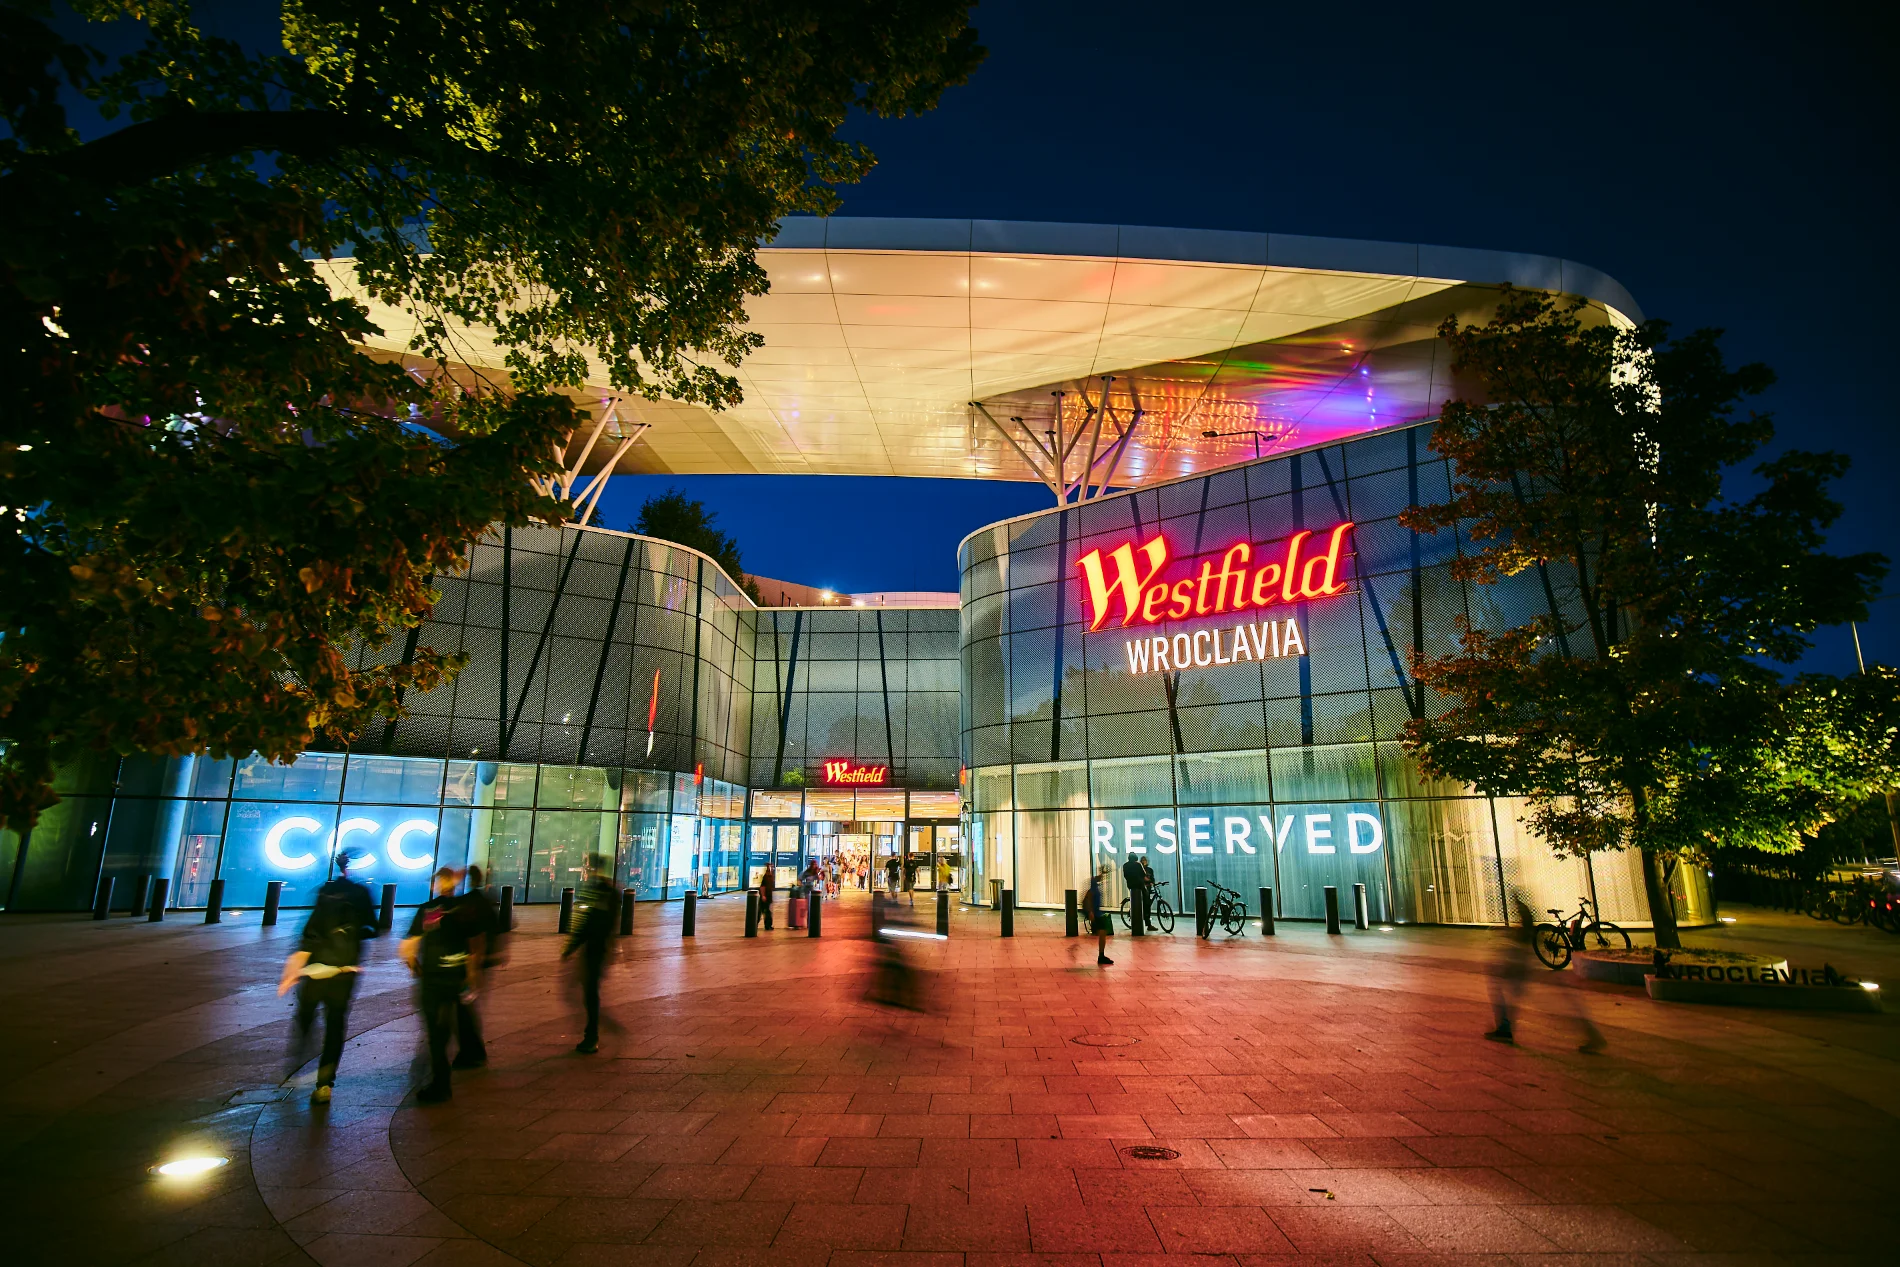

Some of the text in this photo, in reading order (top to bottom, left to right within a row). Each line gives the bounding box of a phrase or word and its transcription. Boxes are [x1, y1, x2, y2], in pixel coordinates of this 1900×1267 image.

[1075, 522, 1354, 631] Westfield
[1126, 618, 1305, 675] WROCLAVIA
[825, 761, 886, 783] Westfield
[264, 816, 439, 870] CCC
[1094, 813, 1384, 855] RESERVED
